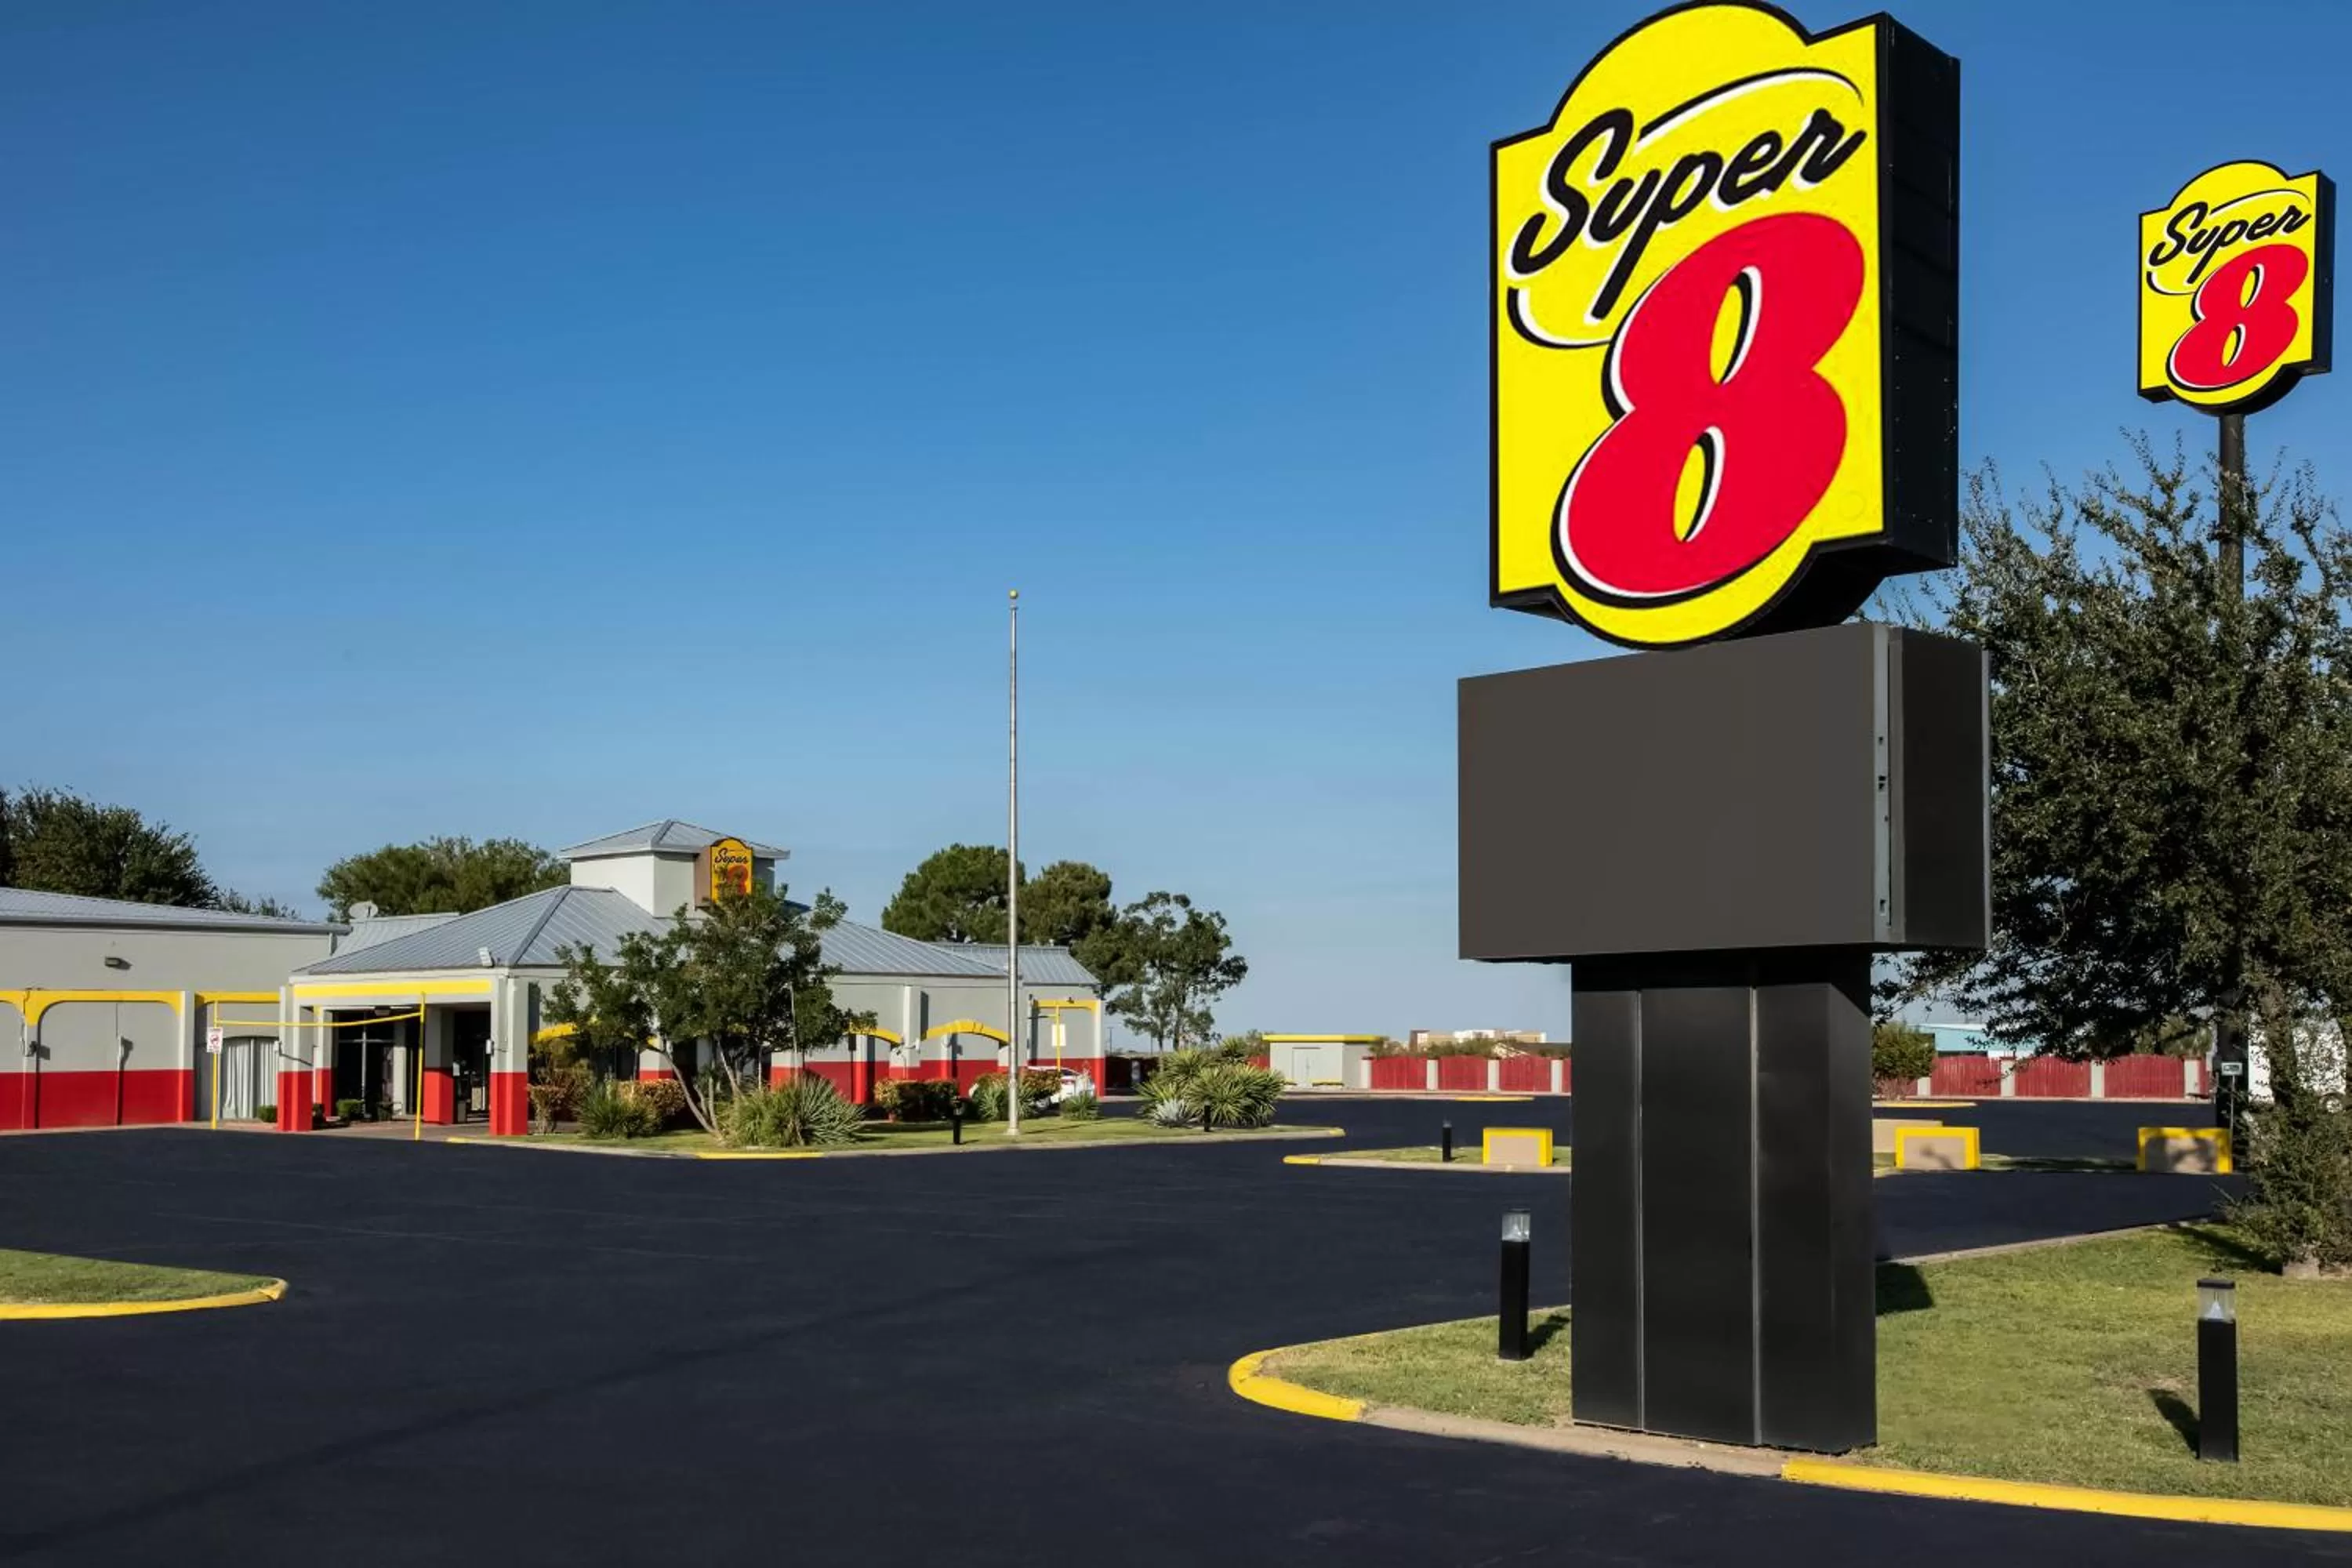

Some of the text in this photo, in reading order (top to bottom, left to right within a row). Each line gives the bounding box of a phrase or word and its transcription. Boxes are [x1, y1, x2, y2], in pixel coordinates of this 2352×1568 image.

[1512, 108, 1867, 320] Super
[2149, 201, 2311, 285] Super
[2165, 244, 2308, 392] 8
[1551, 212, 1864, 608] 8
